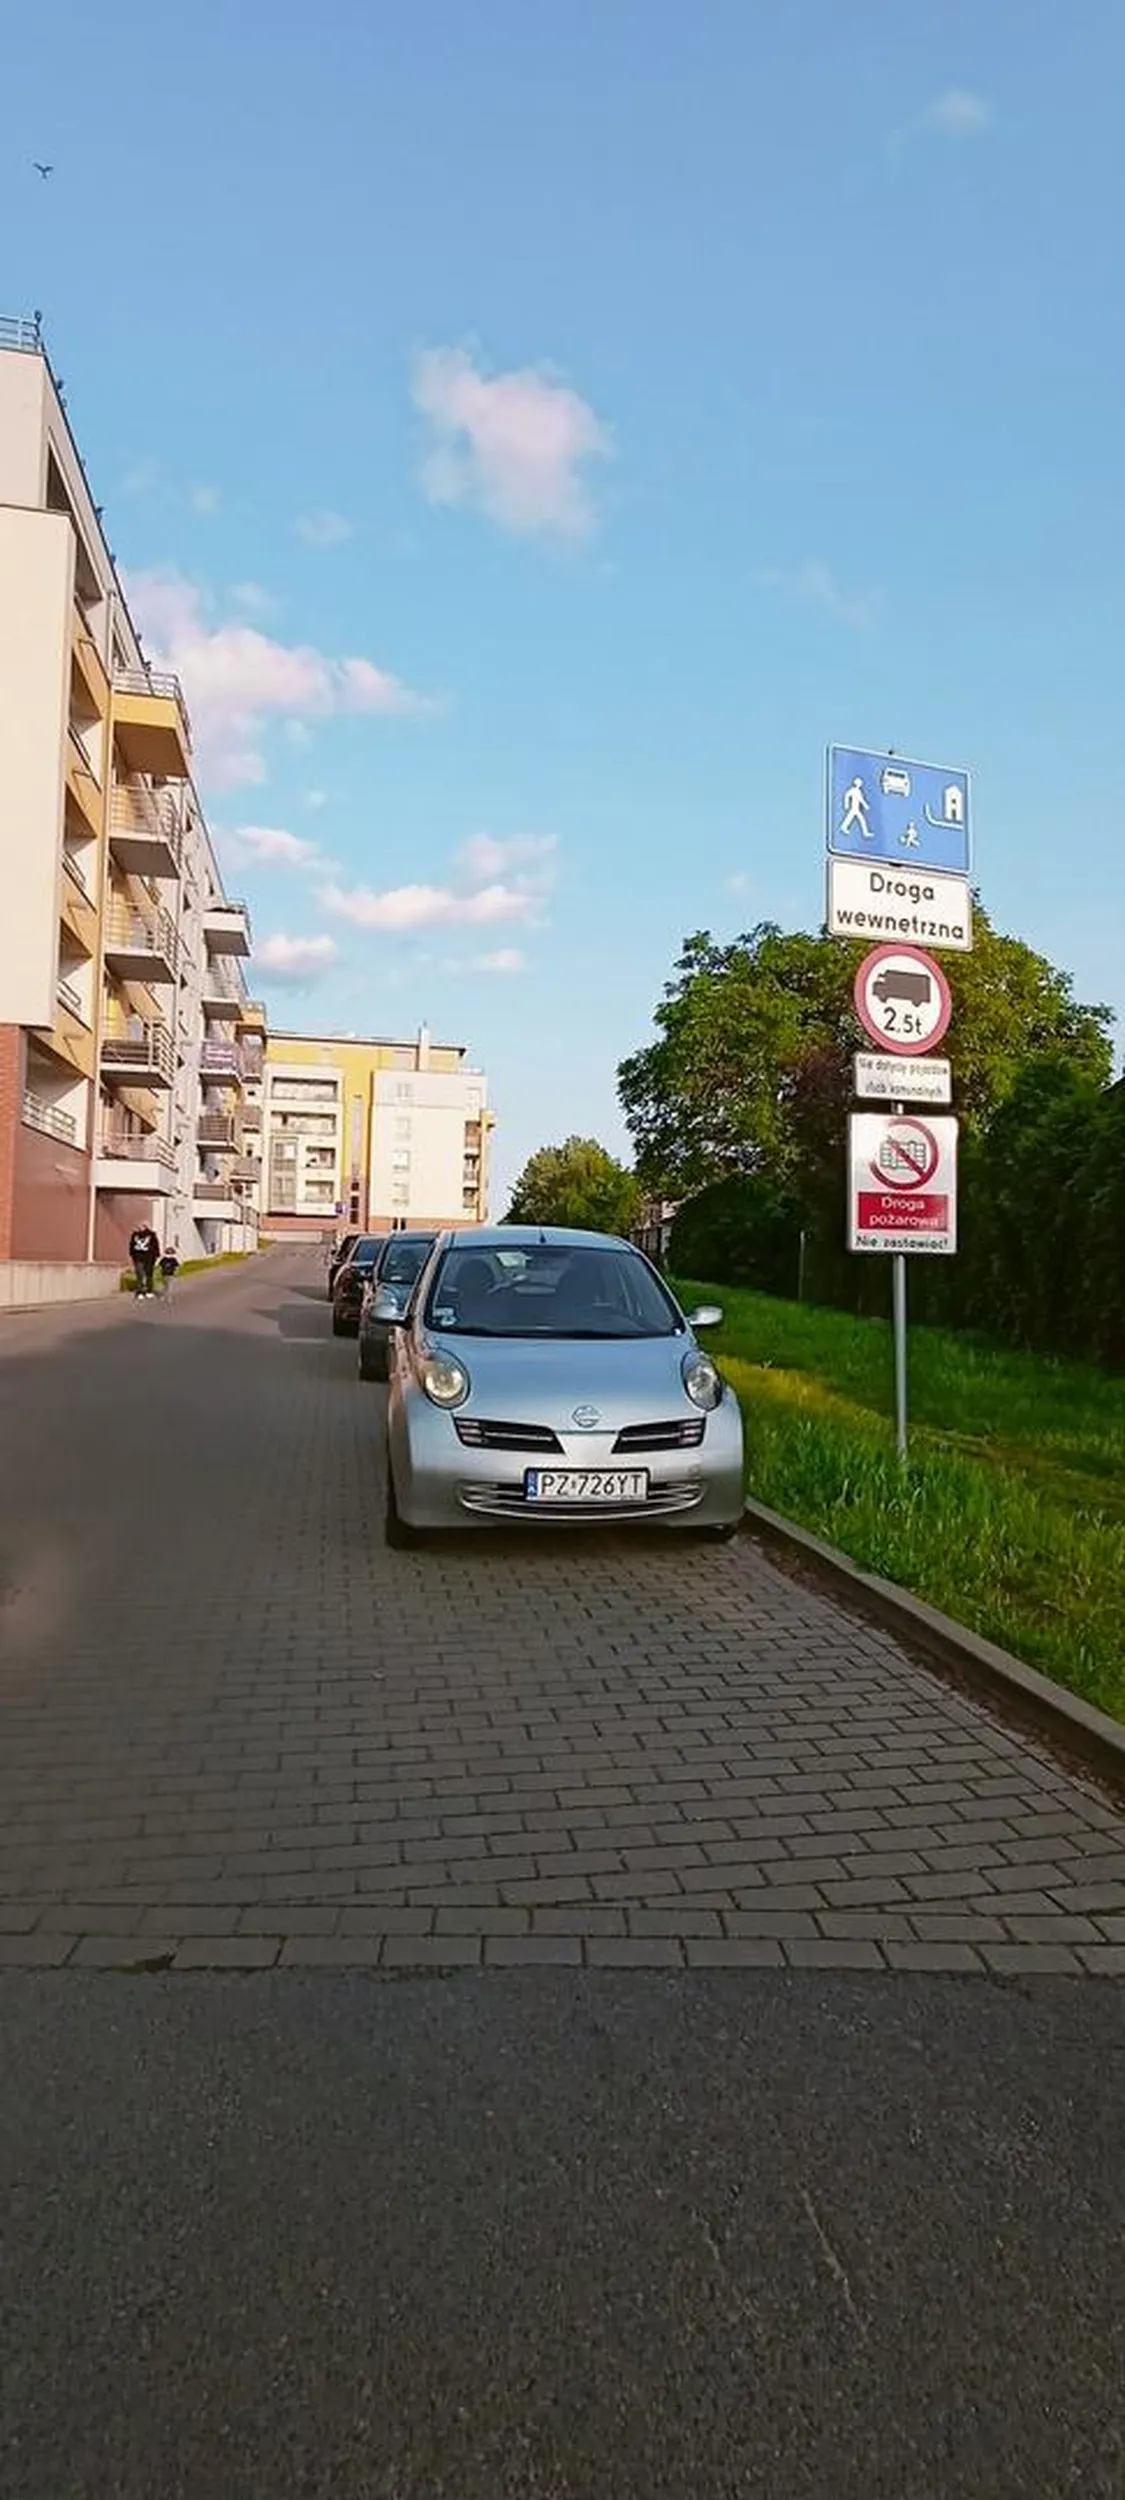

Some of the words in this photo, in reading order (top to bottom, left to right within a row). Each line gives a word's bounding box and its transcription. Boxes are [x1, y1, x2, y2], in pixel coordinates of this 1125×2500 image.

[869, 872, 934, 904] Droga
[881, 1196, 925, 1211] Droga
[856, 1235, 878, 1247] Nie
